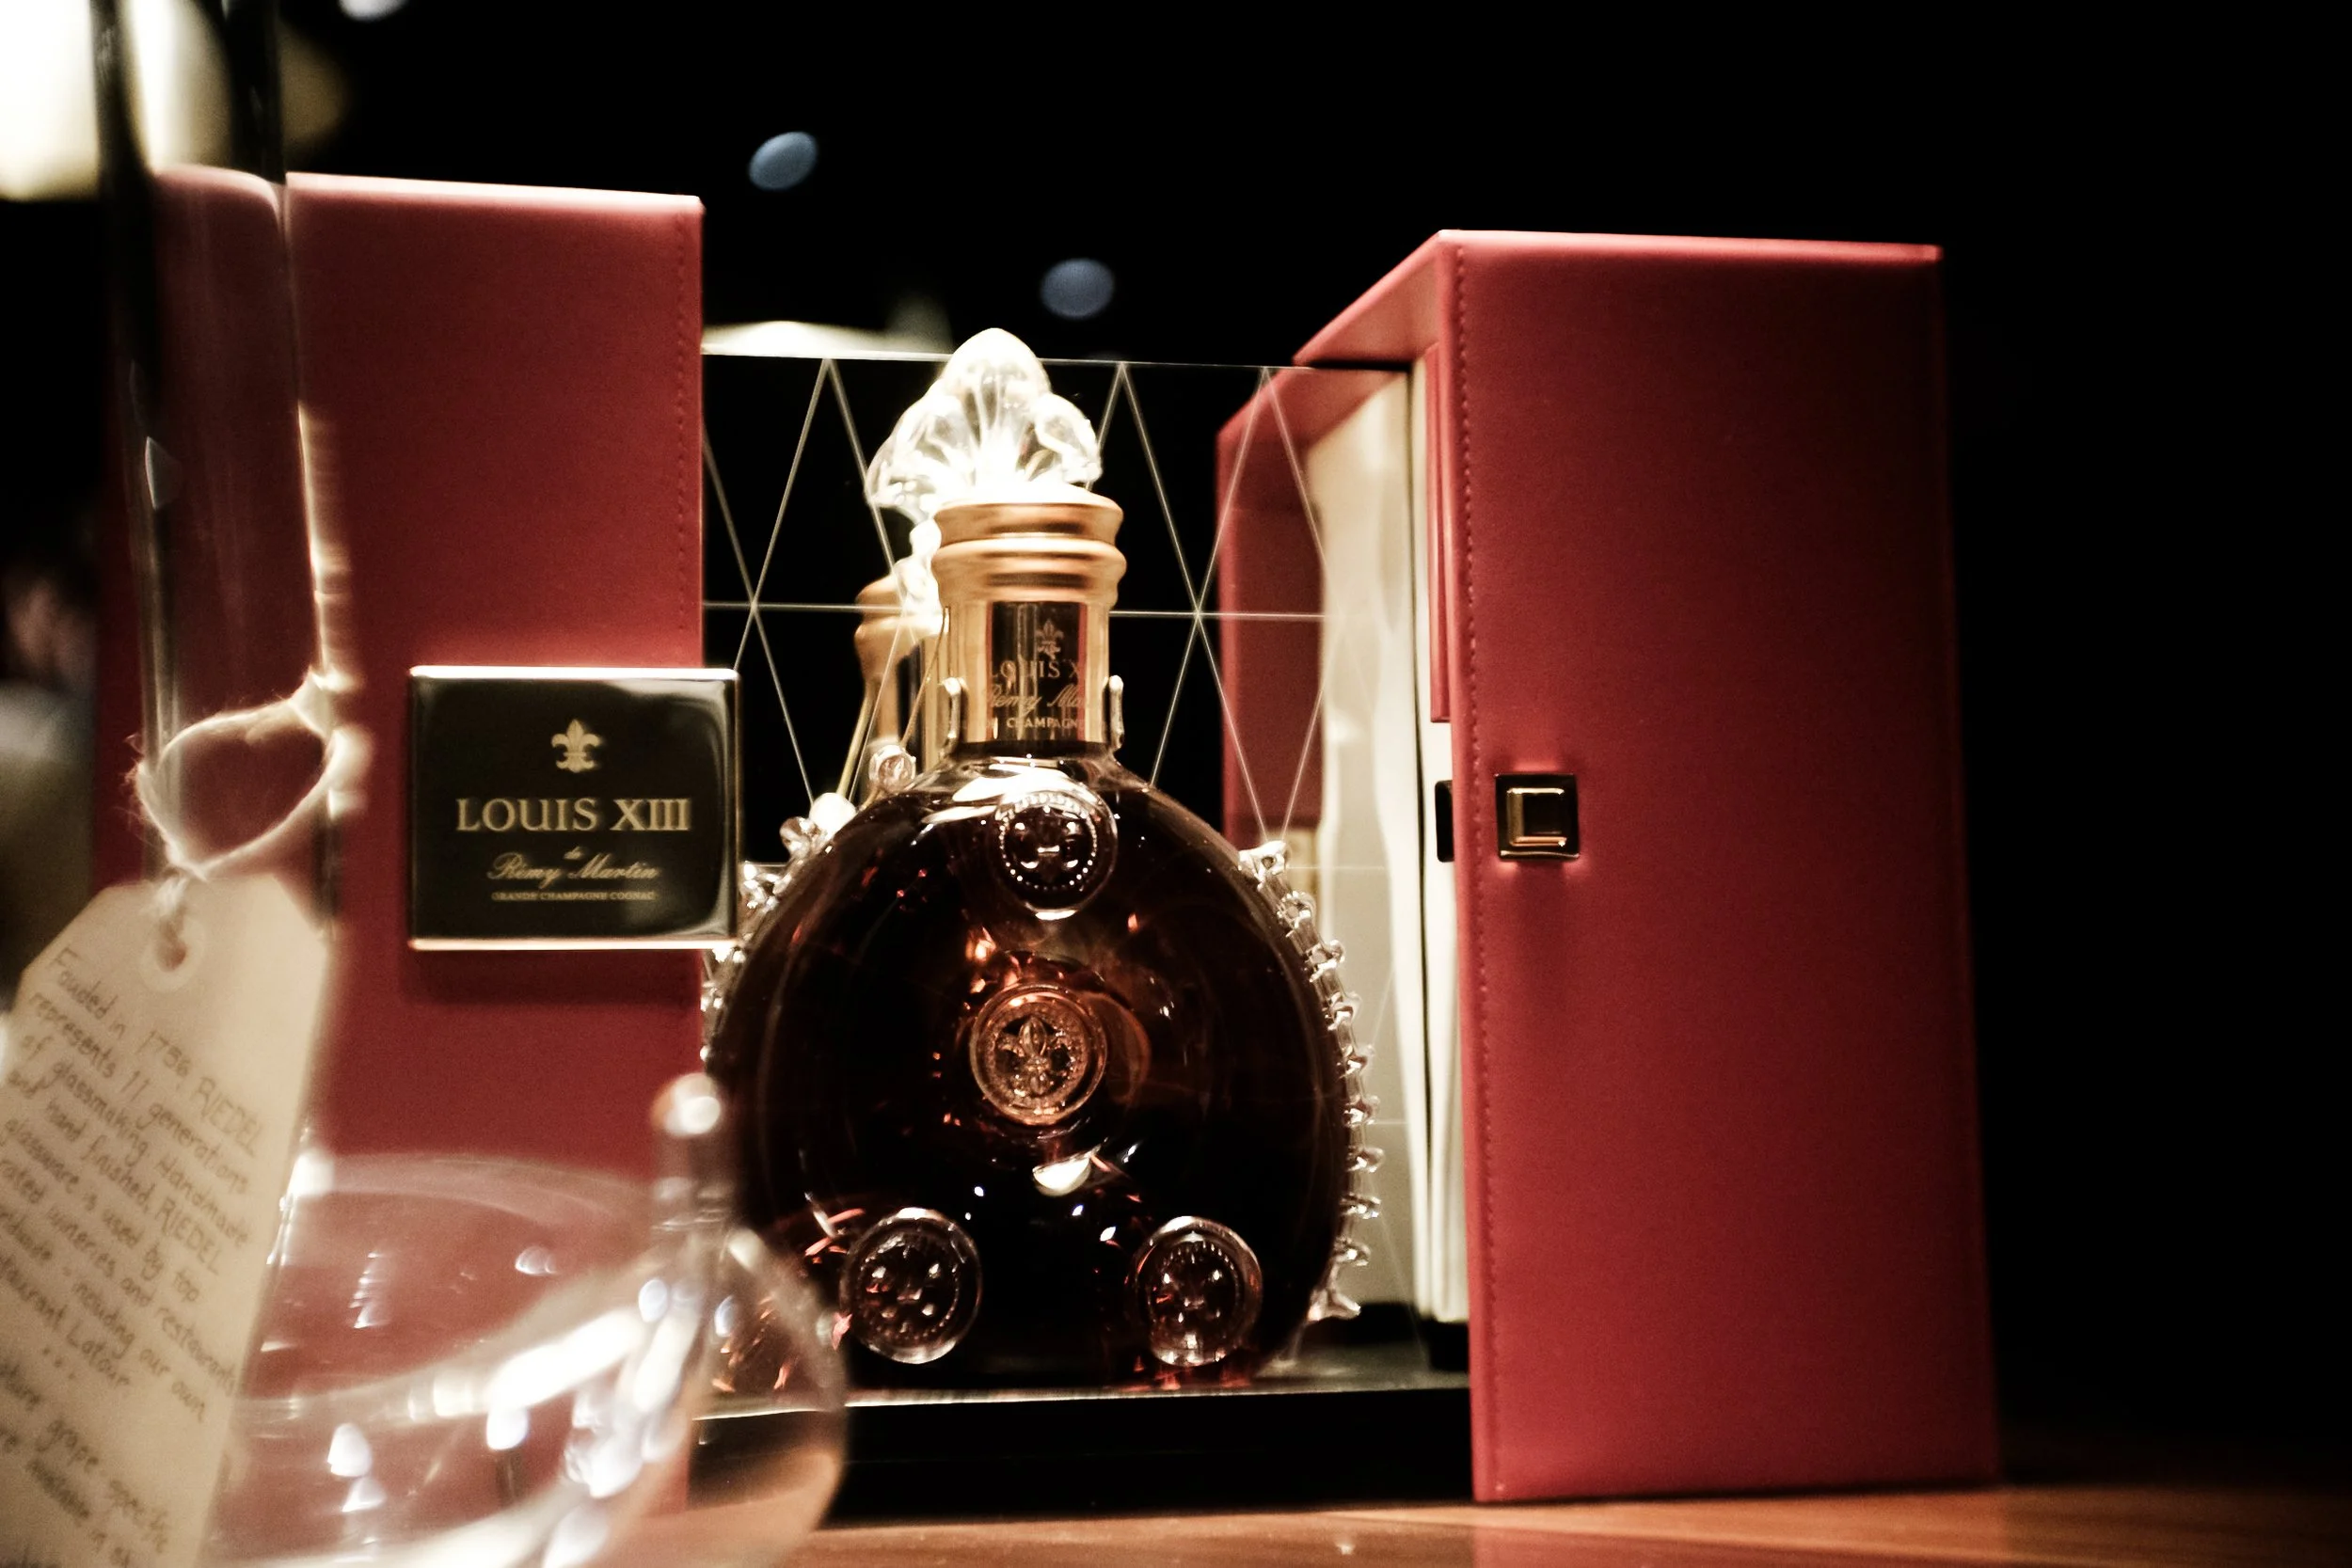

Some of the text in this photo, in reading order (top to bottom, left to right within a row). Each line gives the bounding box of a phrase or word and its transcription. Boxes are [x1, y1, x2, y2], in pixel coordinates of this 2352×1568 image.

[456, 798, 691, 832] LOUIS XIII
[491, 891, 656, 900] GRANDE CHAMPAGNE COGNAC
[567, 852, 660, 879] Martin
[28, 992, 248, 1195] represents 11 generations
[190, 1076, 262, 1158] RIEDEL
[154, 1153, 248, 1248] Handmade
[154, 1196, 222, 1275] RIEDEL
[120, 1276, 157, 1308] and
[141, 1241, 164, 1282] by
[173, 1268, 200, 1304] top
[141, 1349, 171, 1377] our
[171, 1381, 206, 1423] own
